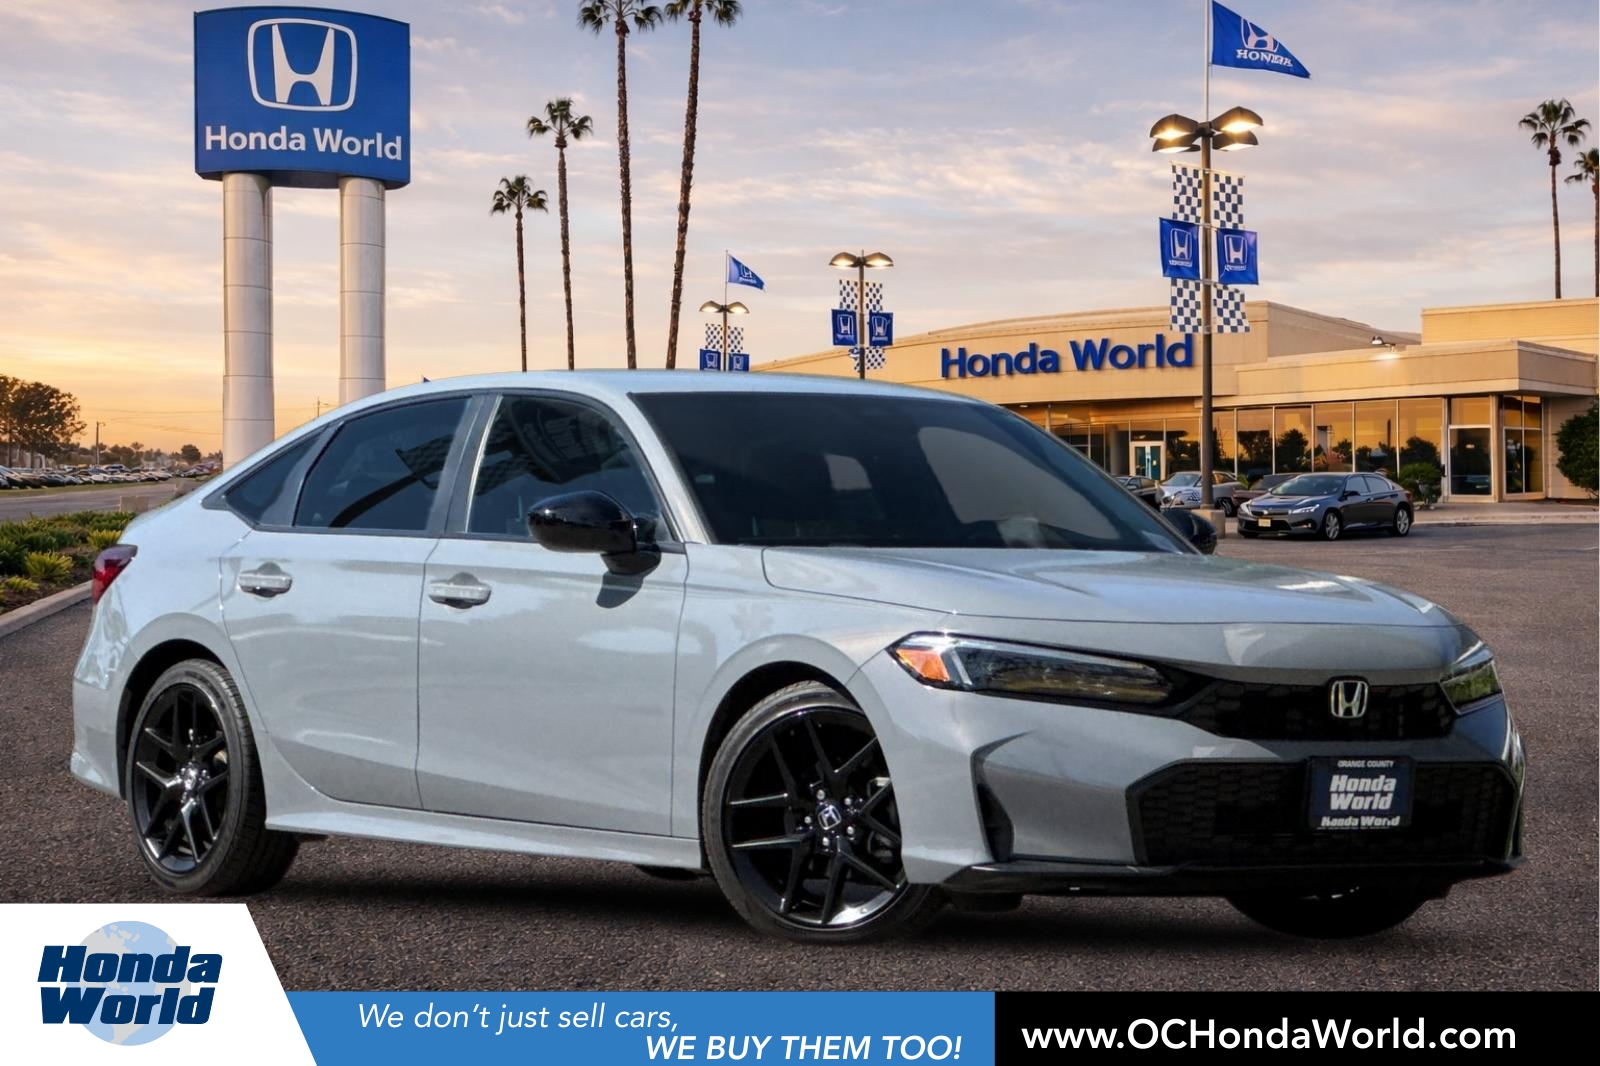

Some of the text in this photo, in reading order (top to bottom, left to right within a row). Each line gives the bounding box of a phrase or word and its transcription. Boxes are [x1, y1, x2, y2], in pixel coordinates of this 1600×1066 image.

[205, 125, 403, 161] Honda World
[941, 333, 1193, 378] Honda World
[1367, 760, 1394, 768] COUNTY
[1329, 774, 1397, 792] Honda
[1330, 792, 1394, 810] World
